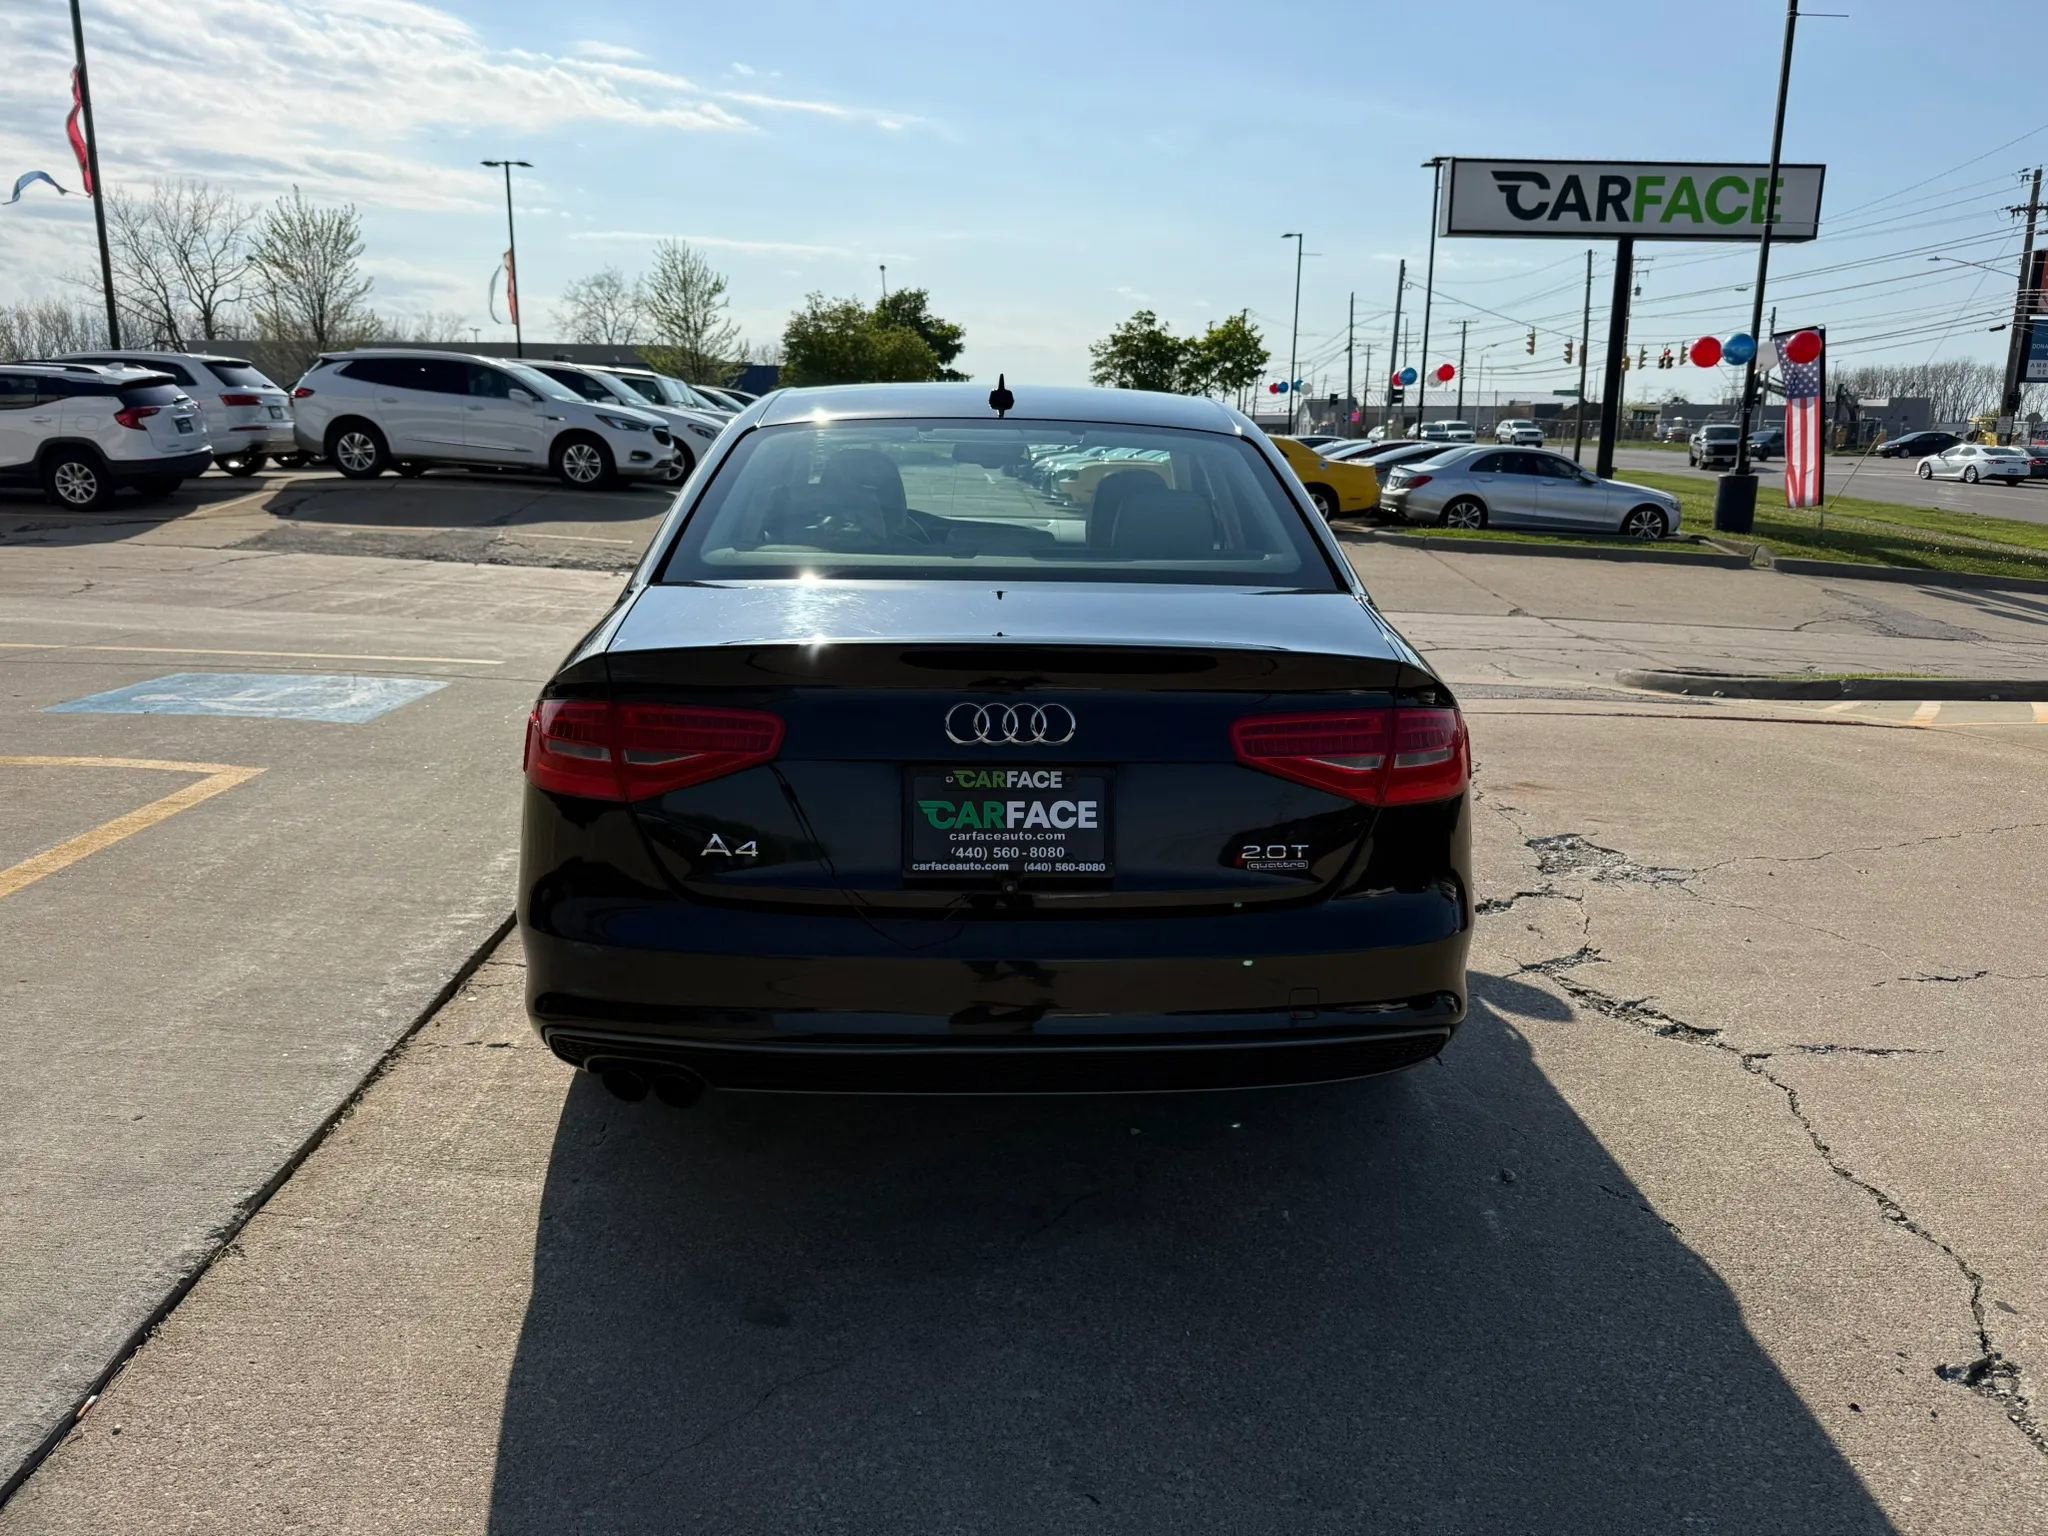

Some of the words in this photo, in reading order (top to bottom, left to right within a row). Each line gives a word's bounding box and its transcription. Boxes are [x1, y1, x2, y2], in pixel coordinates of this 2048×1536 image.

[1491, 170, 1785, 225] CARFACE
[953, 770, 1063, 789] CARFACE
[917, 800, 1098, 830] CARFACE
[700, 833, 759, 857] A4
[949, 831, 1066, 841] carfaceauto.com
[912, 861, 1009, 871] carfaceauto.com
[1024, 862, 1052, 872] (440)
[1055, 862, 1106, 872] 560-8080
